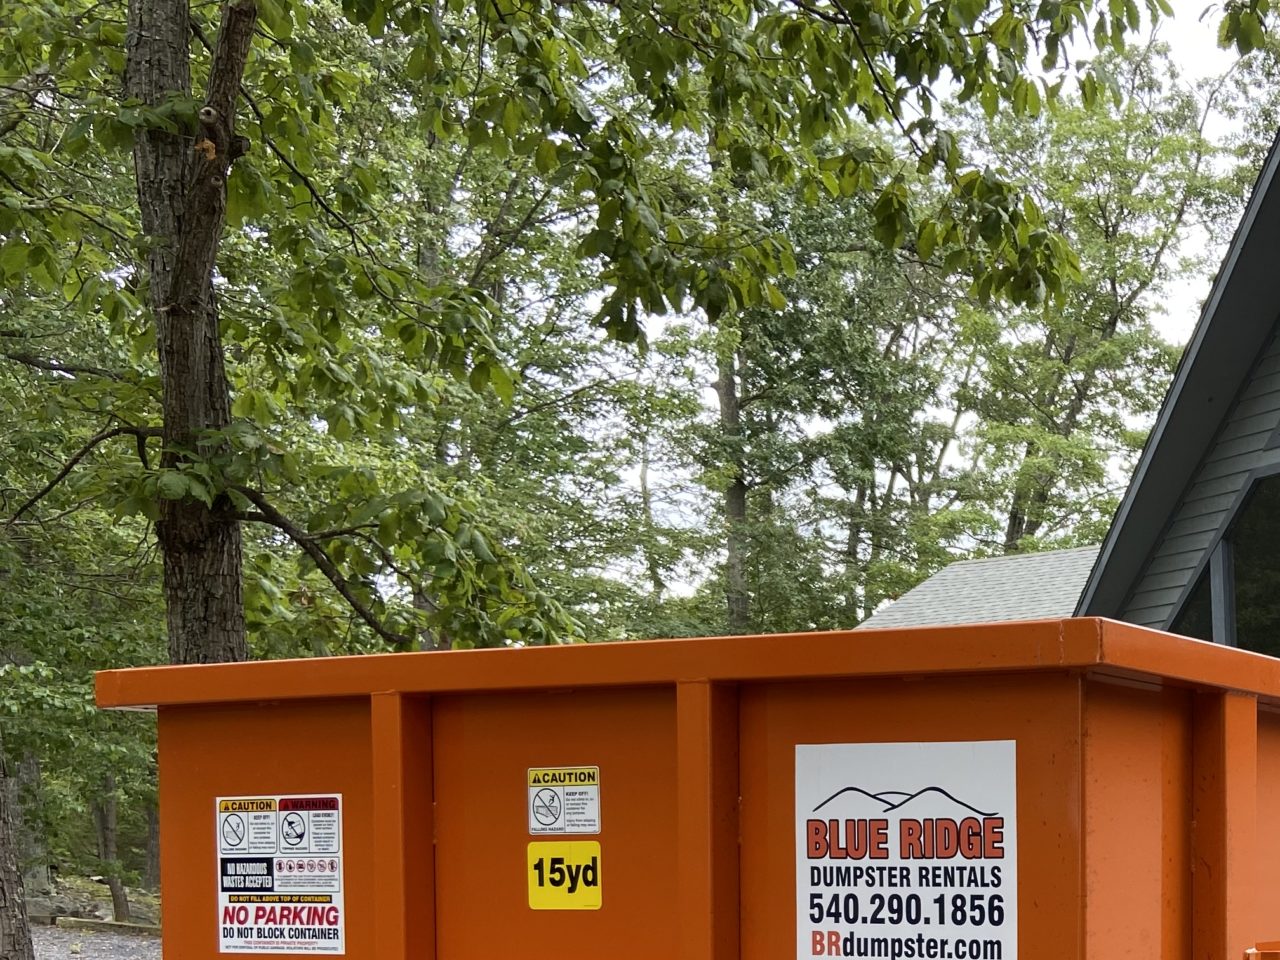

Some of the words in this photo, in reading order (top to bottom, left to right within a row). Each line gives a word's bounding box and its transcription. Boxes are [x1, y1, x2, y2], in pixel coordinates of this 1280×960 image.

[542, 771, 596, 784] CAUTION
[231, 801, 272, 811] CAUTION
[291, 799, 336, 810] WARNING
[806, 818, 889, 860] BLUE
[899, 816, 1005, 860] RIDGE
[227, 863, 236, 875] NO
[236, 863, 268, 875] HAZARDOUS
[533, 856, 598, 894] 15yd
[223, 876, 244, 888] WASTES
[245, 876, 273, 888] ACCEPTED
[810, 866, 911, 888] DUMPSTER
[918, 866, 1001, 888] RENTALS
[222, 905, 249, 925] NO
[254, 905, 339, 926] PARKING
[809, 893, 1005, 926] 540.290.1856
[222, 926, 235, 939] DO
[237, 927, 254, 939] NOT
[257, 927, 286, 939] BLOCK
[288, 927, 339, 940] CONTAINER
